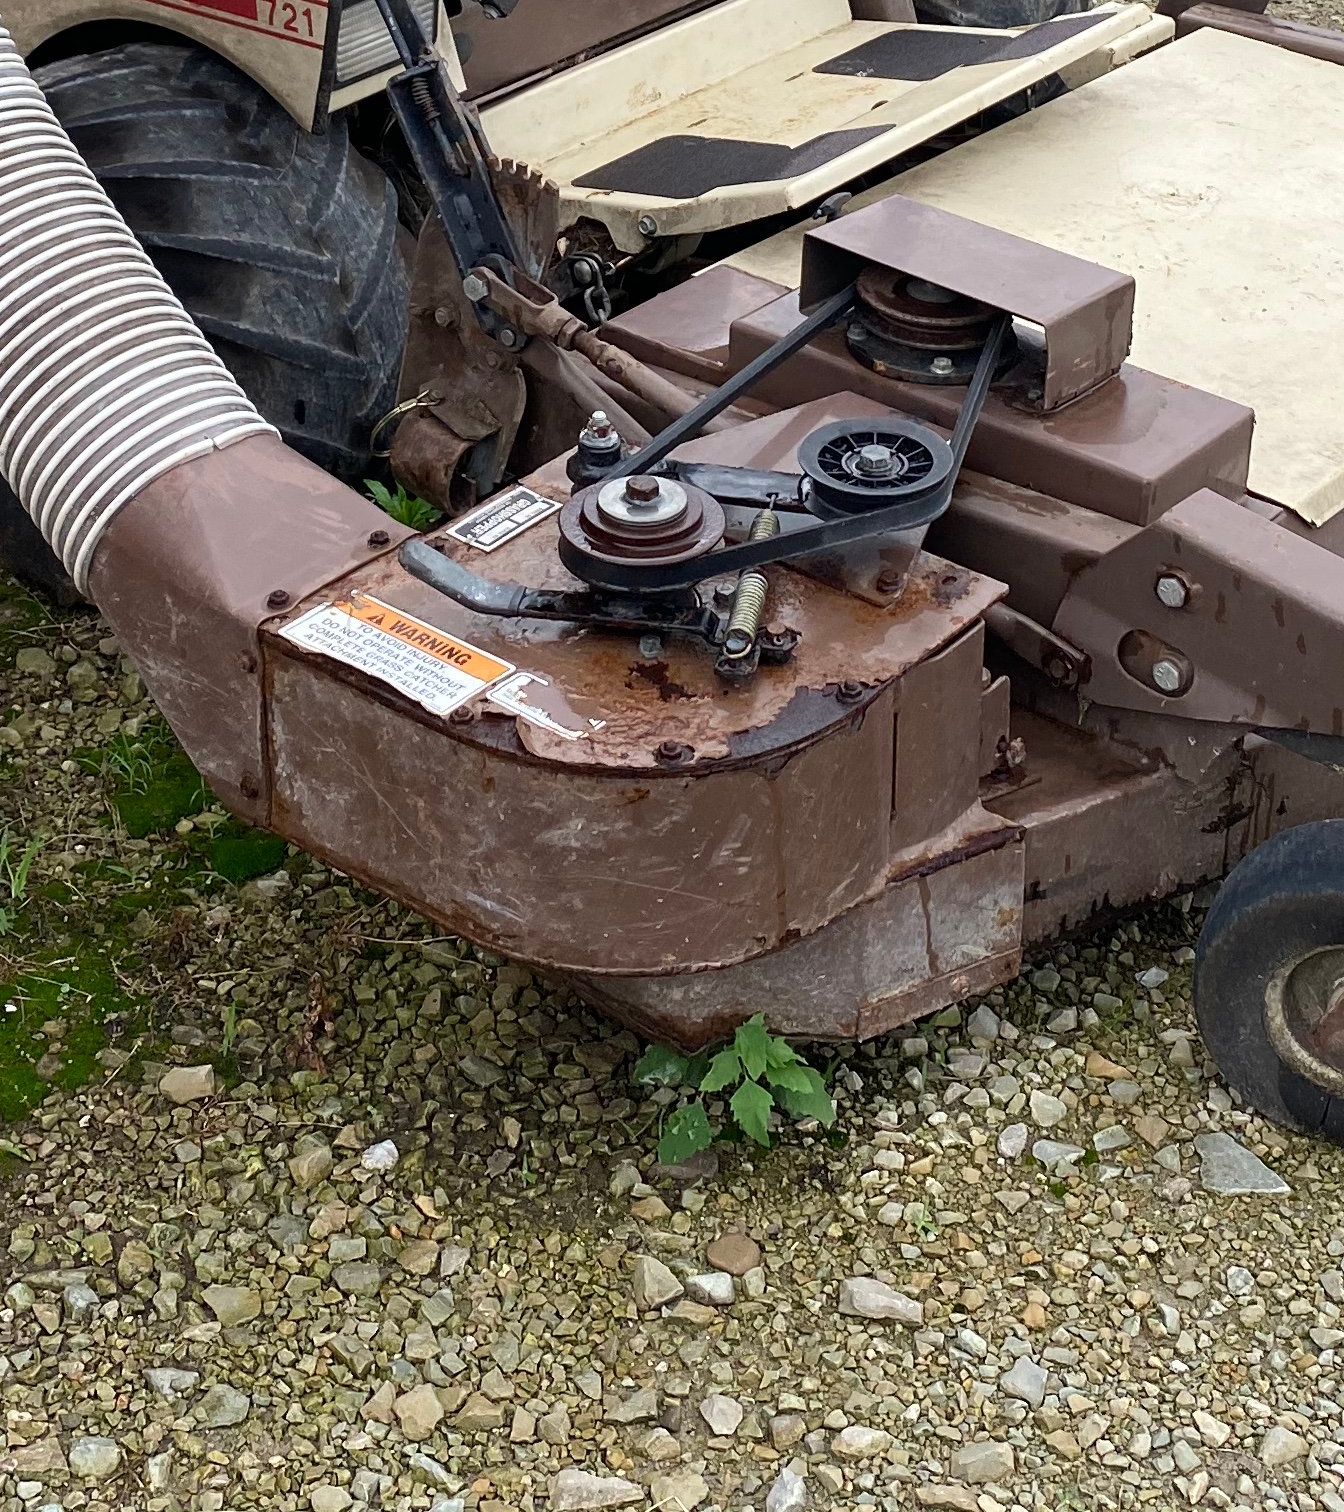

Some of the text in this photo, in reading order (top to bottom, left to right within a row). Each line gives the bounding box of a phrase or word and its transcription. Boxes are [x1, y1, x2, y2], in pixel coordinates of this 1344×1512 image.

[303, 633, 377, 672] ATTACHMENT
[308, 622, 458, 700] COMPLETE GRASS CATCHER
[321, 617, 467, 693] DO NOT OPERATE WITHOUT
[357, 623, 374, 636] TO
[374, 630, 407, 653] AVOID
[389, 620, 473, 667] WARNING
